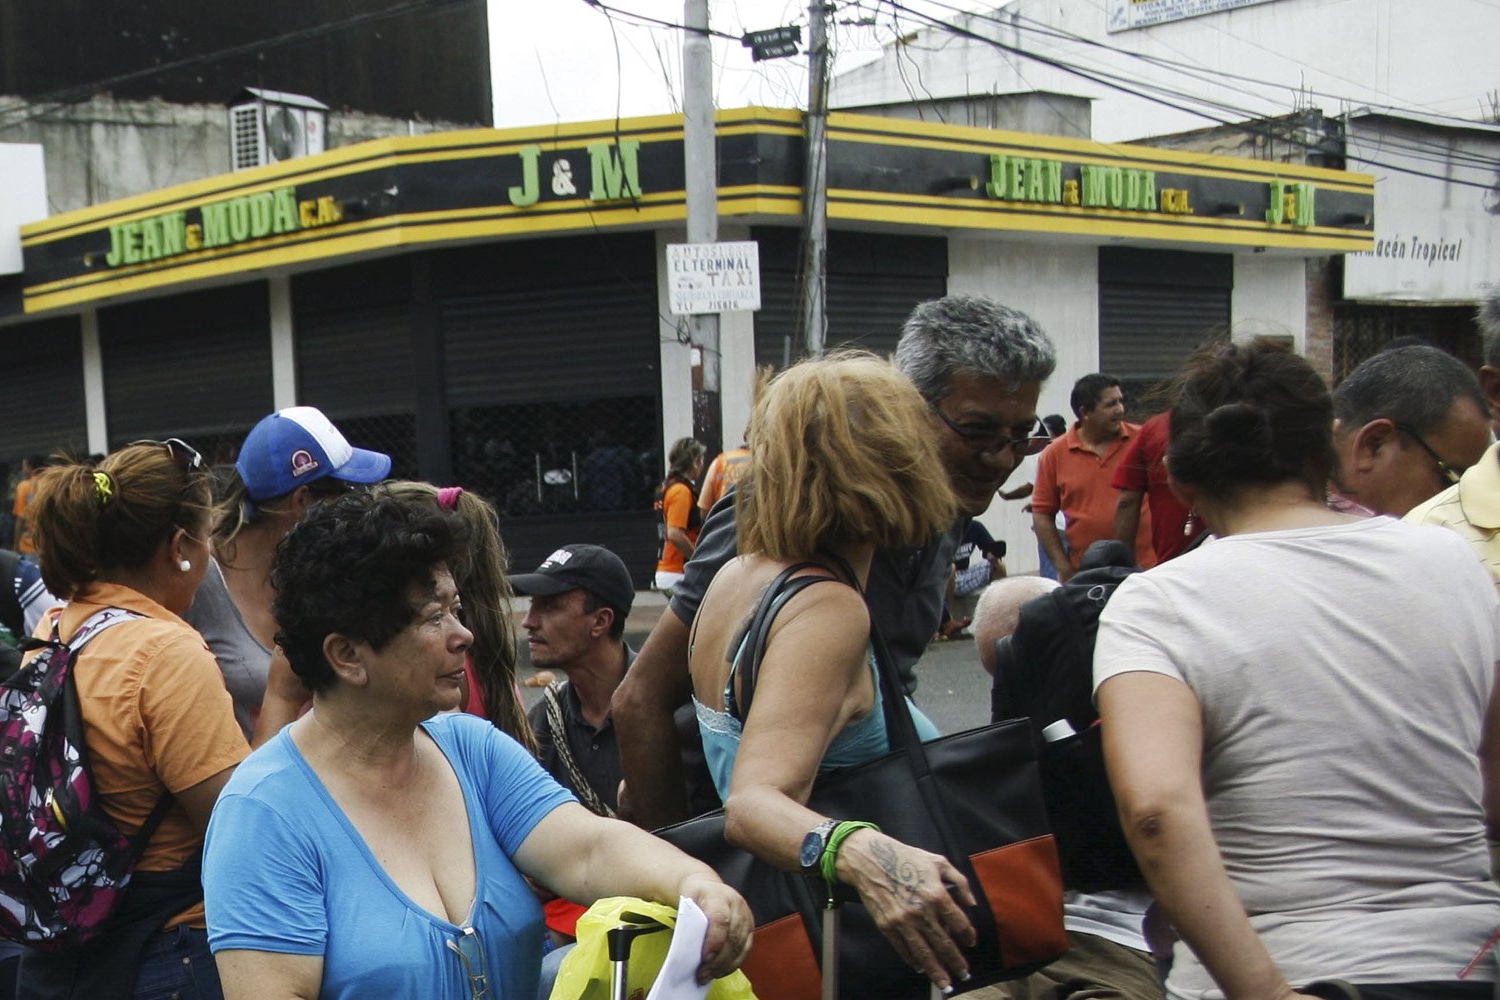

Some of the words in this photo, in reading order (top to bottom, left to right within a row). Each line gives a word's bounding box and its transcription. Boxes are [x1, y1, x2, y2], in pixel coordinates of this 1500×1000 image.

[508, 145, 541, 207] J
[551, 158, 577, 196] &
[587, 139, 644, 201] M
[986, 153, 1062, 203] JEAN
[1081, 165, 1157, 211] MODA
[106, 211, 187, 268] JEAN
[200, 184, 299, 249] MODA
[1410, 235, 1463, 268] Tropical
[706, 270, 754, 288] TAXI
